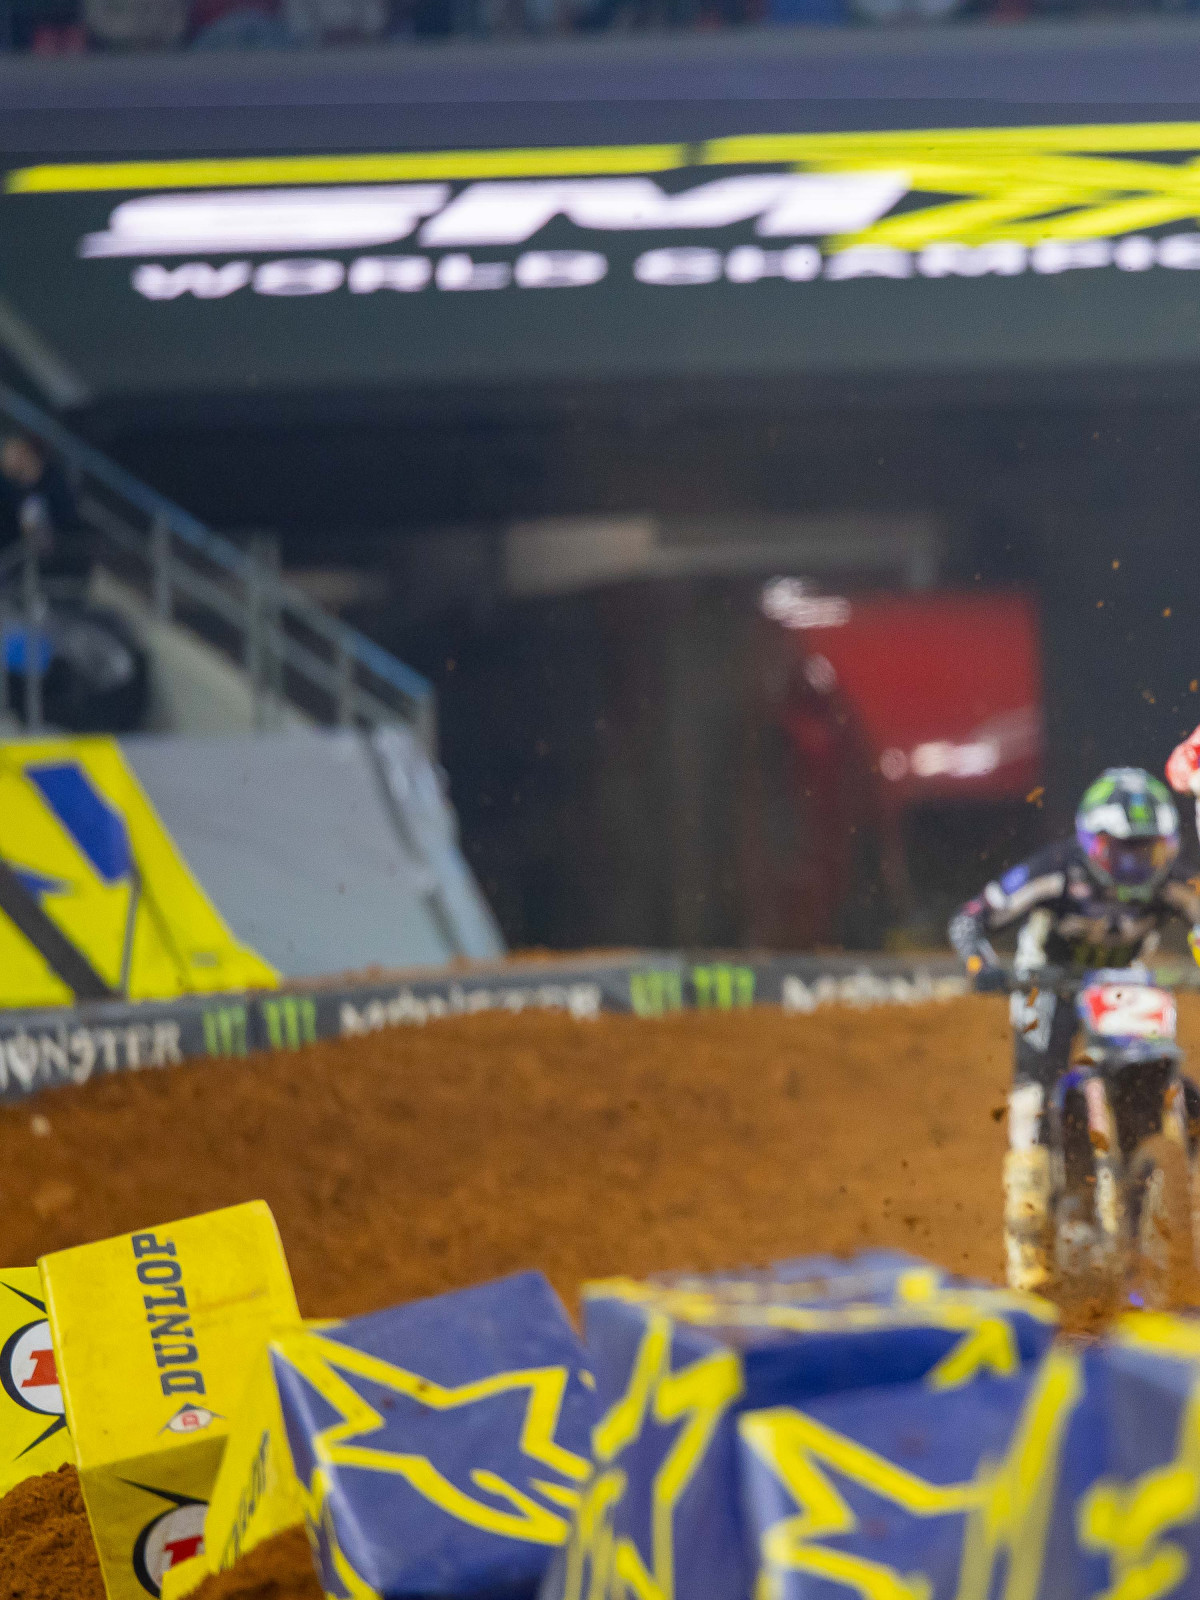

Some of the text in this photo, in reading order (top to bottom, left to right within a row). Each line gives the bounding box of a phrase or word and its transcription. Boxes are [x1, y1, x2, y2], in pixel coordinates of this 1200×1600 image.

[131, 249, 608, 301] WORLD
[0, 1020, 182, 1092] ONSTER
[131, 1232, 206, 1397] DUNLOP
